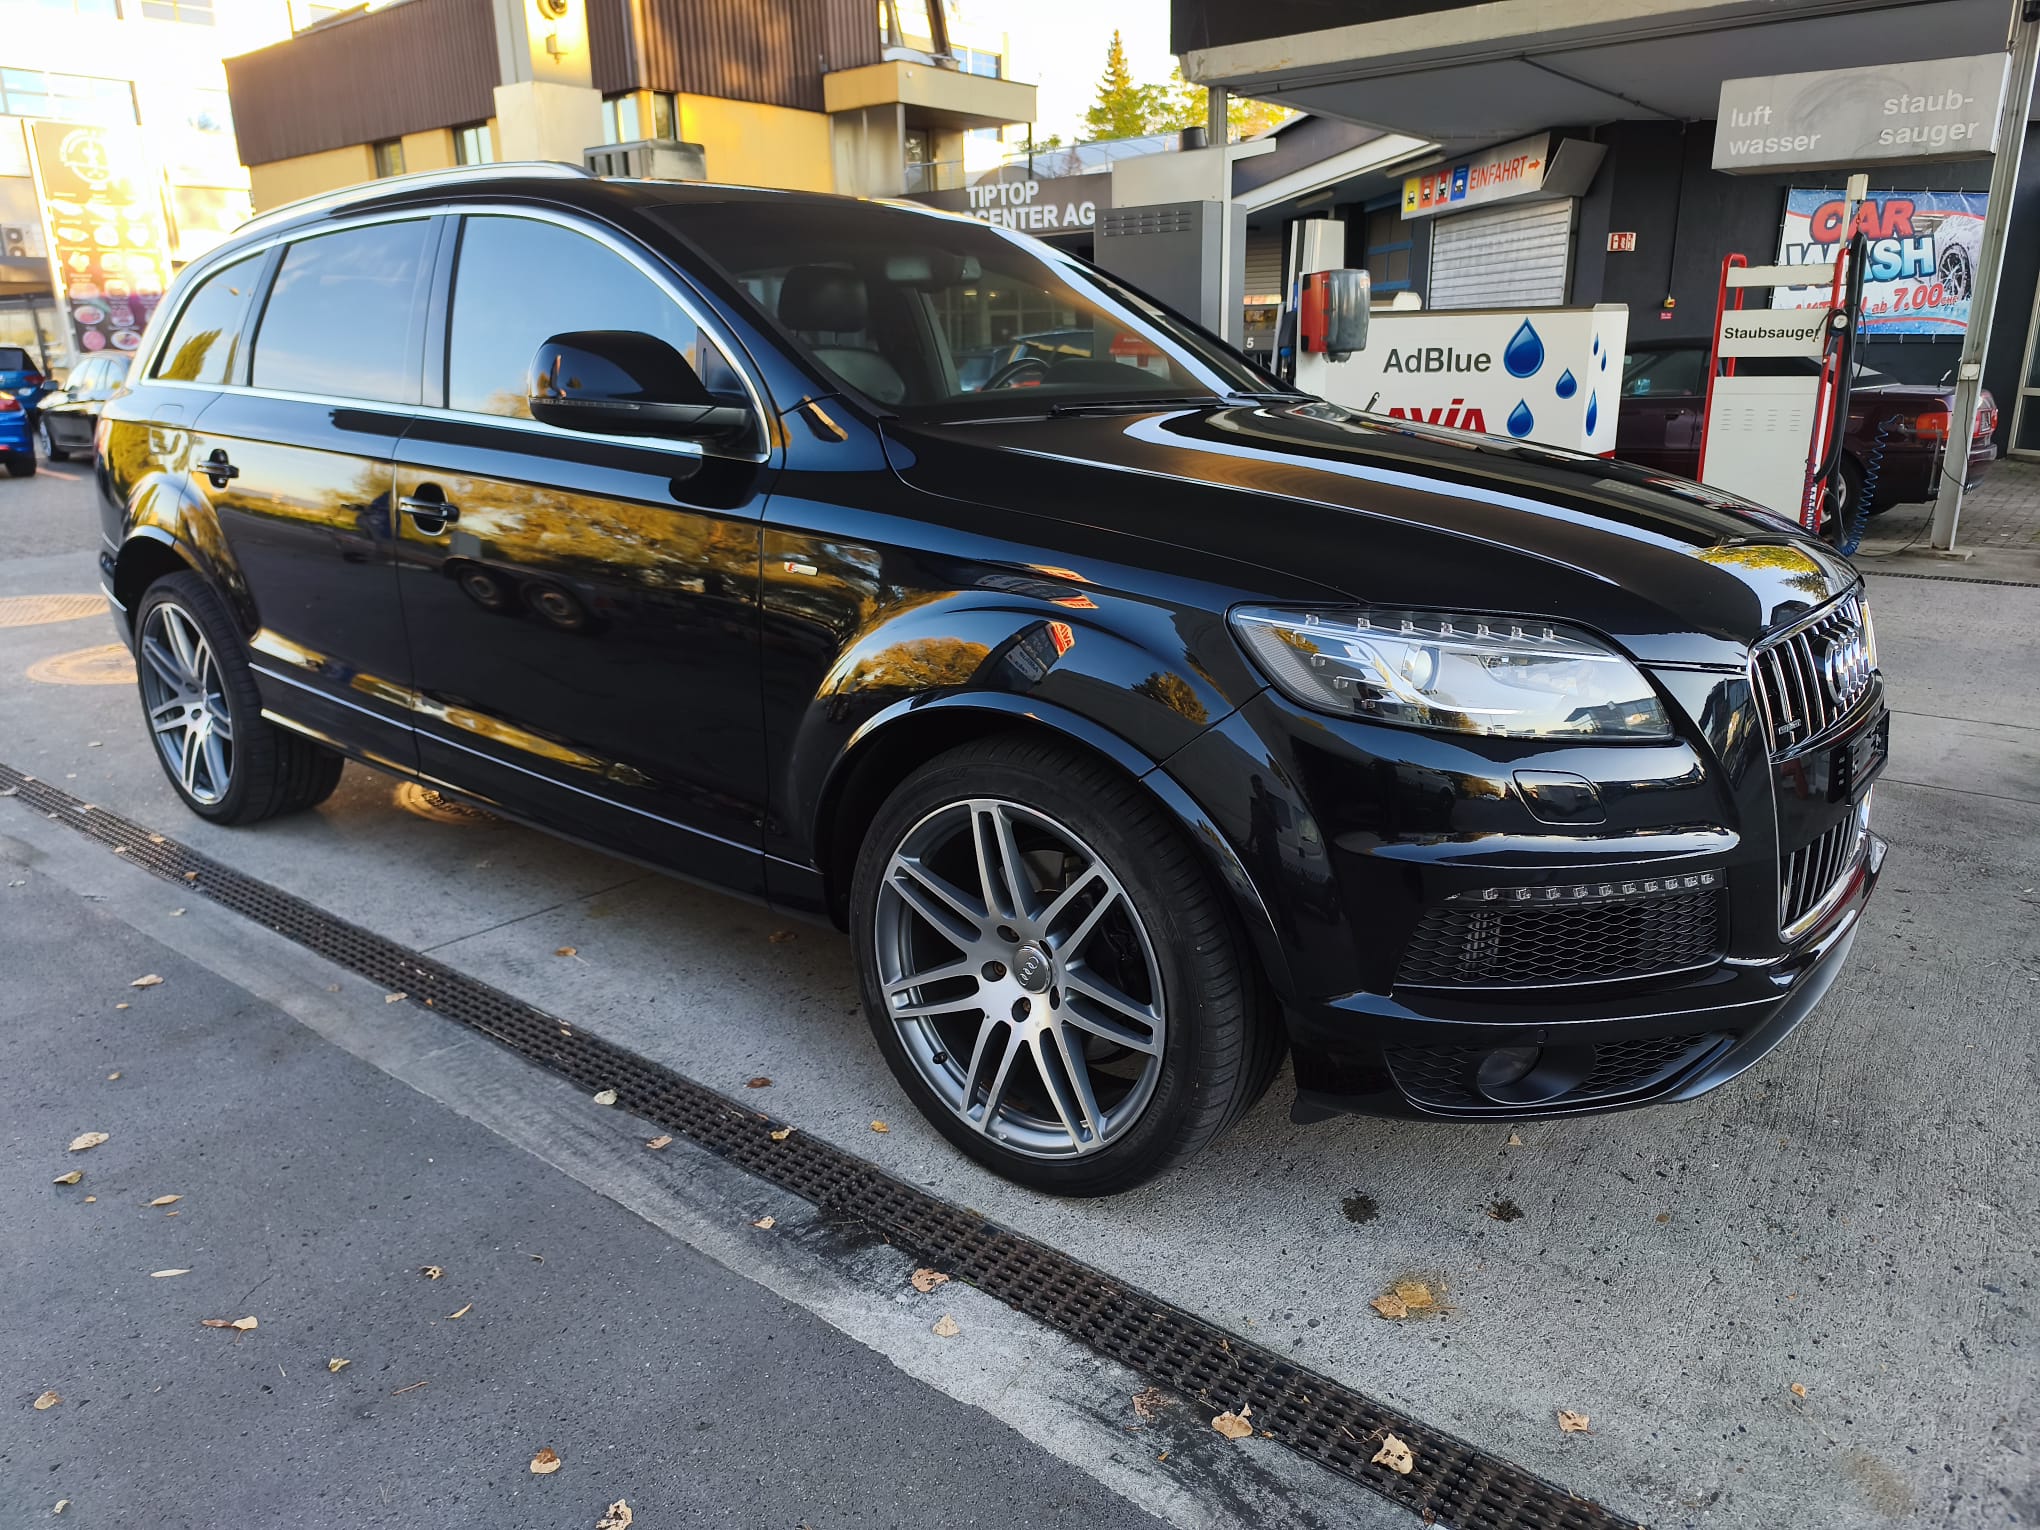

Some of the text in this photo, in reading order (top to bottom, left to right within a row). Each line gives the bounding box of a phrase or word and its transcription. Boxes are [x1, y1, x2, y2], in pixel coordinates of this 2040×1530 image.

[1883, 89, 1974, 116] staub-
[1730, 106, 1772, 128] luft
[1729, 132, 1821, 156] wasser
[1878, 121, 1979, 147] sauger
[1468, 155, 1528, 191] EINFAHRT
[966, 181, 1039, 208] TIPTOP
[1062, 201, 1096, 227] AG
[1809, 199, 1916, 244] CAR
[1893, 282, 1944, 312] 7.00
[1246, 337, 1254, 348] 5
[1724, 327, 1821, 341] Staubsauger
[1383, 347, 1491, 373] AdBlue
